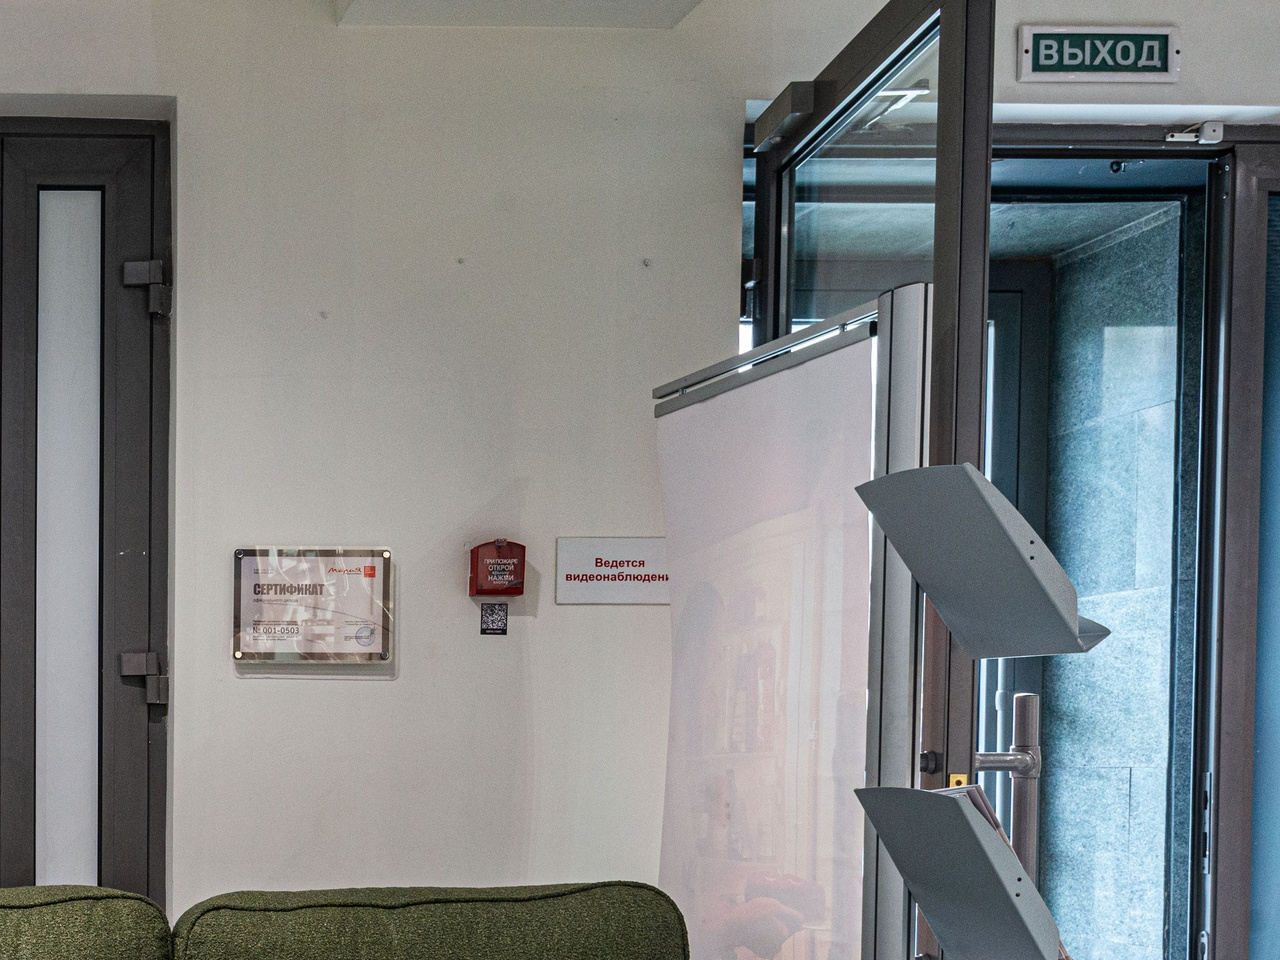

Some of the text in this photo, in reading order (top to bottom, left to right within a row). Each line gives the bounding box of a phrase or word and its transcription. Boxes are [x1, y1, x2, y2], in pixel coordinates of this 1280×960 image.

[1038, 39, 1162, 68] ВЫХОД
[595, 557, 645, 570] Ведется
[253, 583, 325, 596] СЕРТИФИКАТ
[253, 626, 300, 634] № 001-0503
